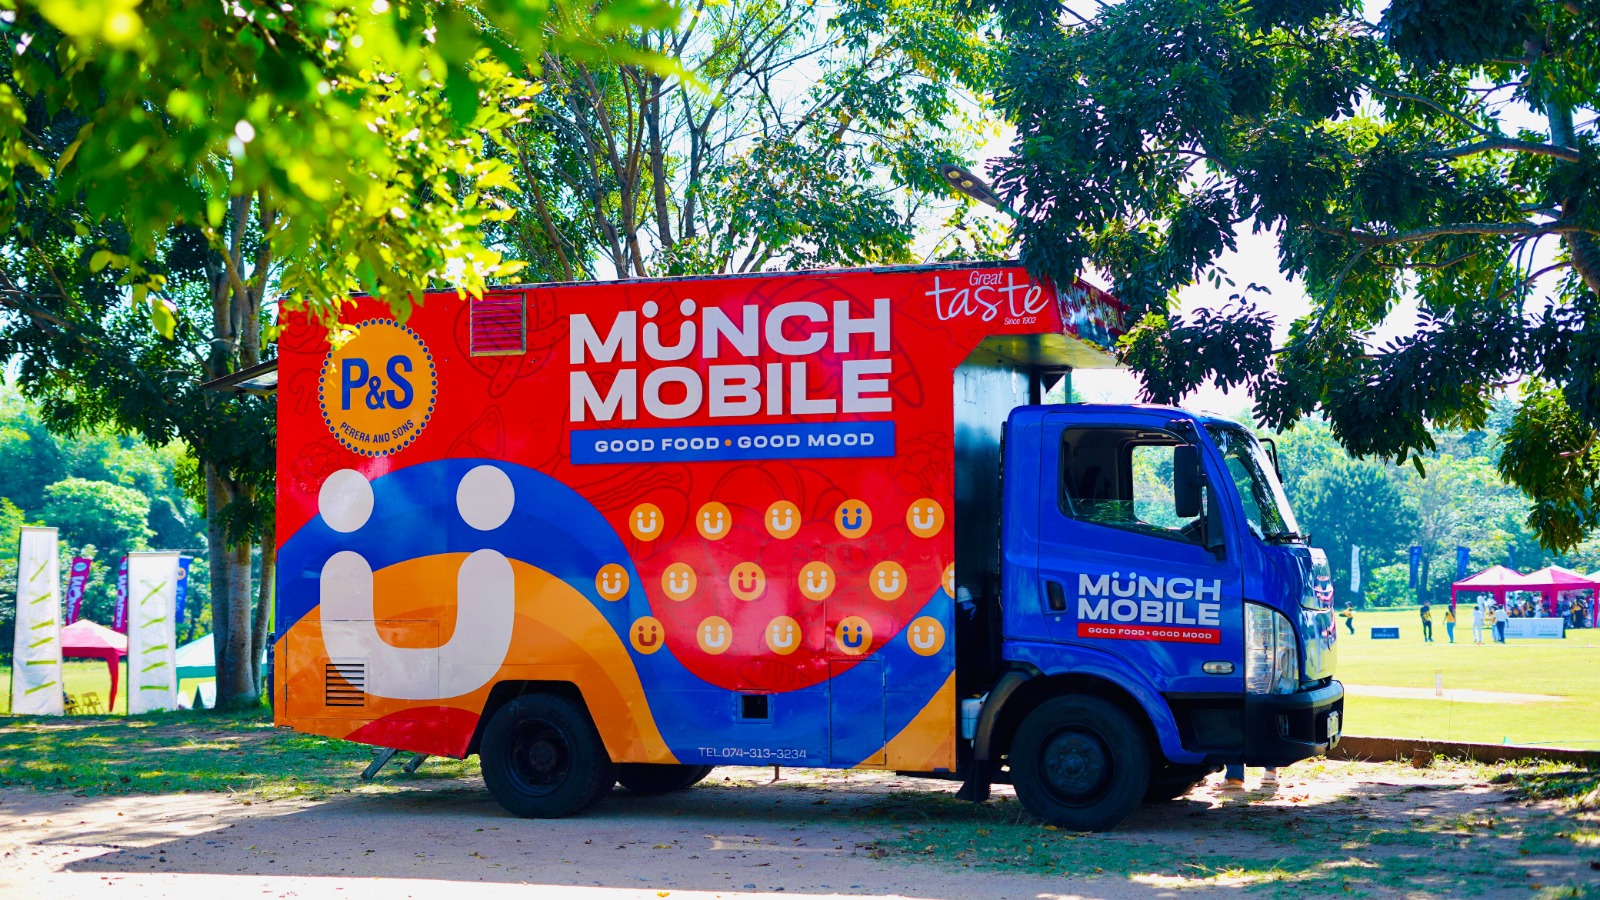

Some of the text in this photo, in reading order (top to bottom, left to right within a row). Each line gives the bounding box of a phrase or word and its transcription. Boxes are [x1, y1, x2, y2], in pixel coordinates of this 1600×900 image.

[969, 270, 1003, 286] Great
[925, 272, 1049, 322] taste
[569, 298, 891, 365] MÜNCH
[1004, 316, 1037, 325] Since 1902
[341, 354, 414, 410] P&S
[569, 358, 893, 422] MOBILE
[340, 419, 414, 443] PERERA AND SONS
[594, 432, 875, 453] GOOD FOOD GOOD MOOD
[1078, 571, 1222, 601] MÜNCH
[1077, 597, 1221, 626] MOBILE
[1088, 627, 1213, 639] GOOD FOOD GOOD MOOD
[698, 747, 807, 759] TEL.074-313-3234
